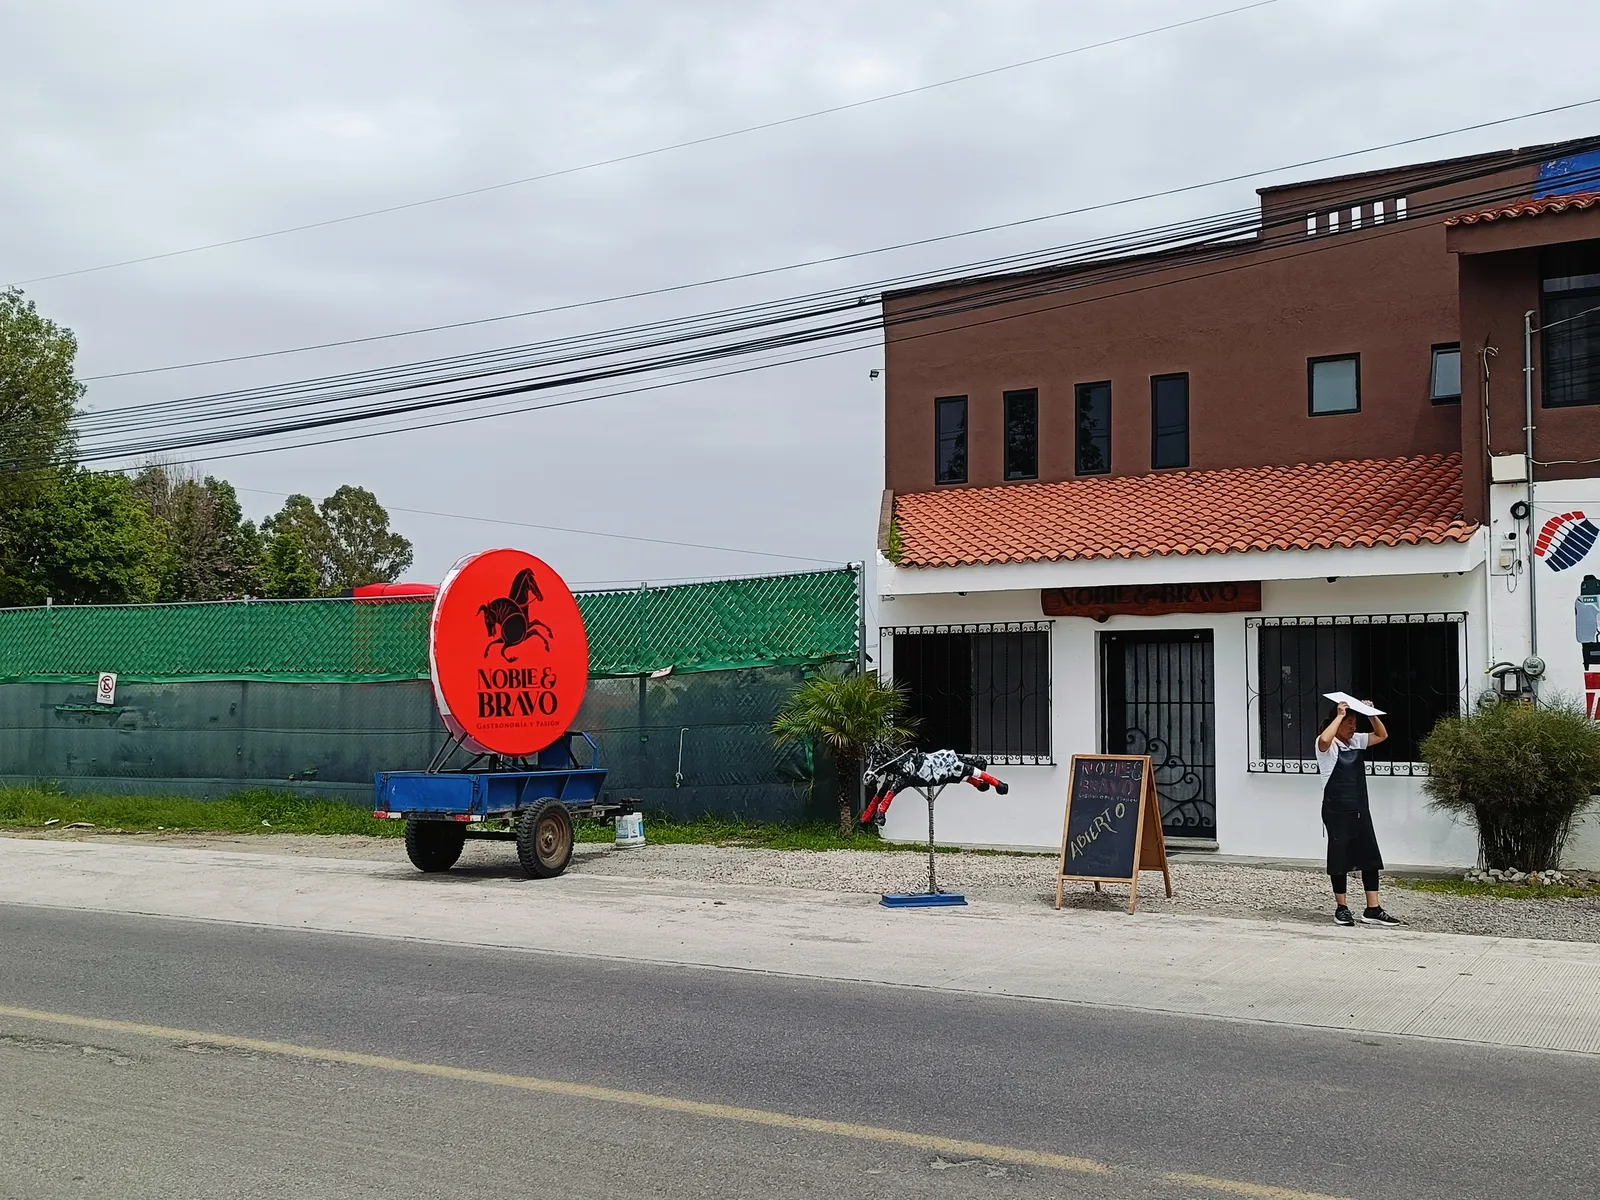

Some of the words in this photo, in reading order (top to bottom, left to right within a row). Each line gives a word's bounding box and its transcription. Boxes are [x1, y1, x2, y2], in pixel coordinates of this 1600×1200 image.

[1162, 583, 1239, 603] BRAVO
[477, 668, 541, 690] NOBLE
[541, 667, 557, 690] &
[477, 691, 558, 718] BRAVO
[1069, 802, 1126, 860] ABIERTO
